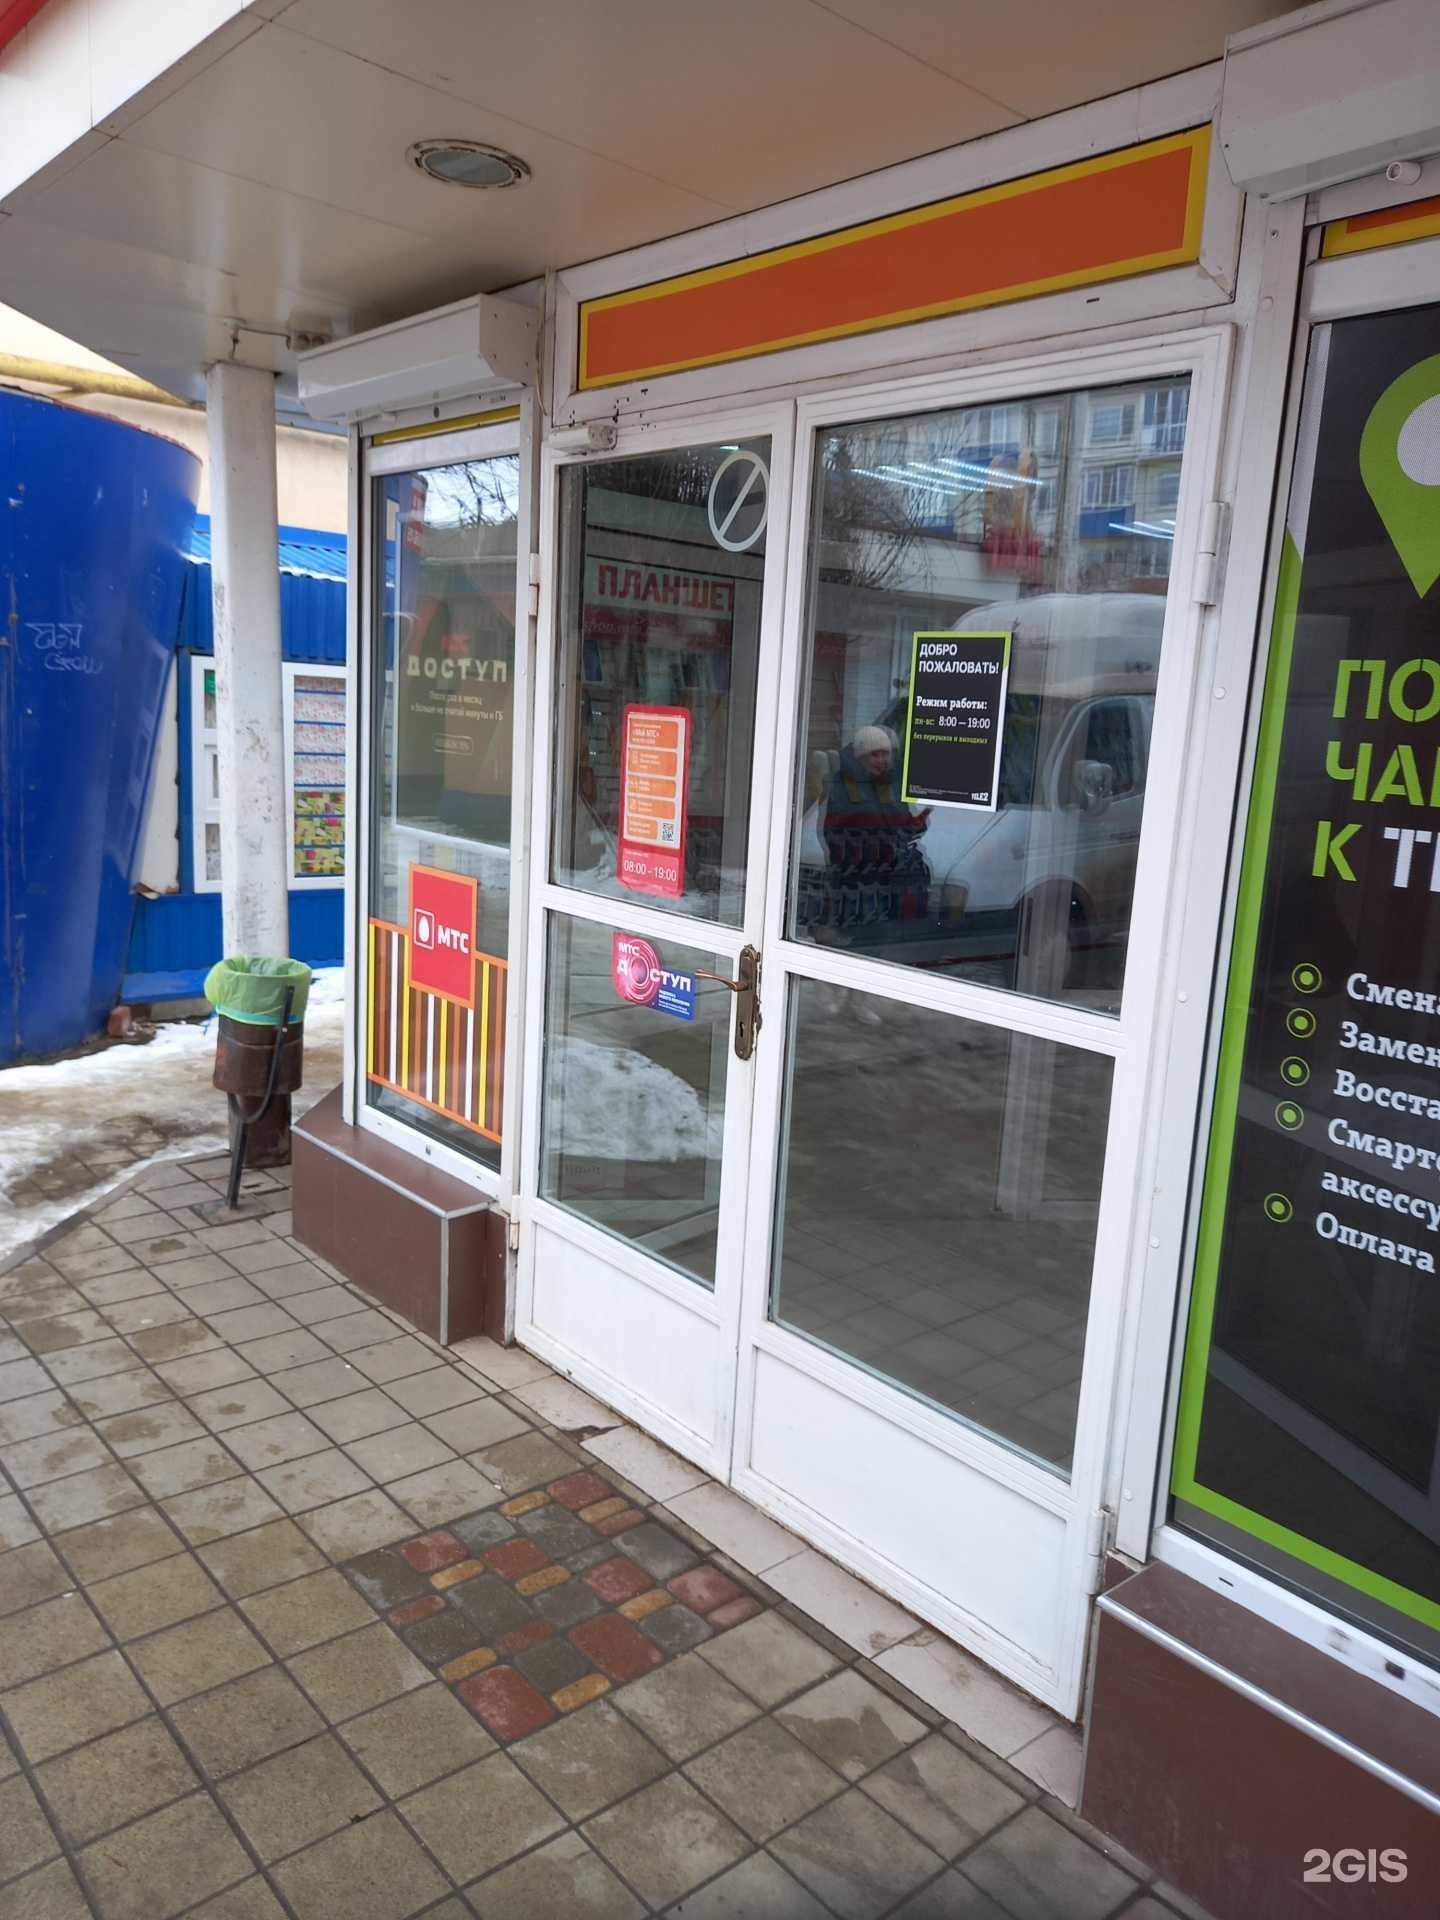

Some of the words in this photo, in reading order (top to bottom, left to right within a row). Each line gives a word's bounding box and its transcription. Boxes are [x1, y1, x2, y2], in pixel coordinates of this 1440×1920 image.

[919, 643, 958, 658] ДОБРО
[407, 655, 507, 682] ДОСТУП
[918, 660, 1000, 674] ПОЖАЛОВАТЬ!
[916, 695, 948, 709] Режим
[949, 697, 988, 711] работы:
[938, 715, 957, 727] 8:00
[967, 717, 991, 729] 19:00
[1326, 741, 1440, 808] ЧА
[1312, 820, 1363, 882] К
[624, 859, 647, 875] 08:00
[655, 866, 677, 882] 19:00
[437, 924, 469, 954] МТС
[618, 942, 640, 956] МТС
[1346, 972, 1440, 1016] Смен
[1327, 1118, 1440, 1172] Смарт
[1316, 1211, 1436, 1274] Оплата
